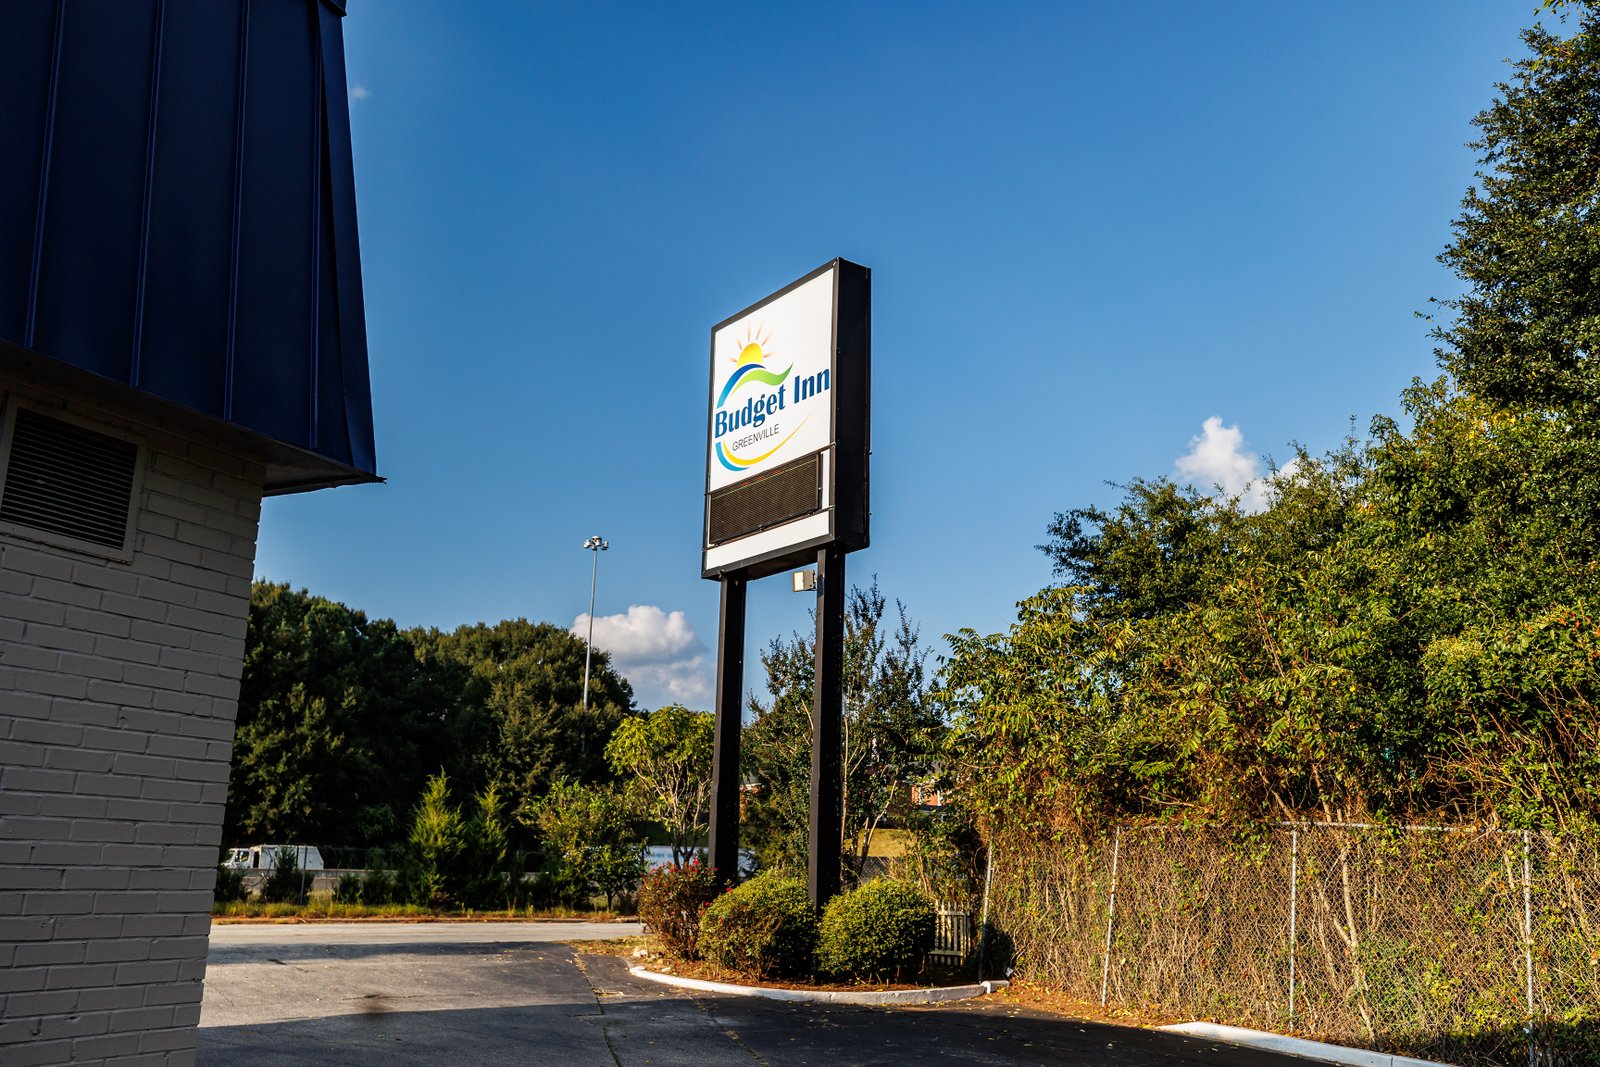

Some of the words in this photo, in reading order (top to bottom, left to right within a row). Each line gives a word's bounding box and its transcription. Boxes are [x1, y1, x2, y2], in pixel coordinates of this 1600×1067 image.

[715, 384, 786, 439] Budget
[794, 368, 830, 404] Inn
[731, 423, 780, 451] GREENVILLE
